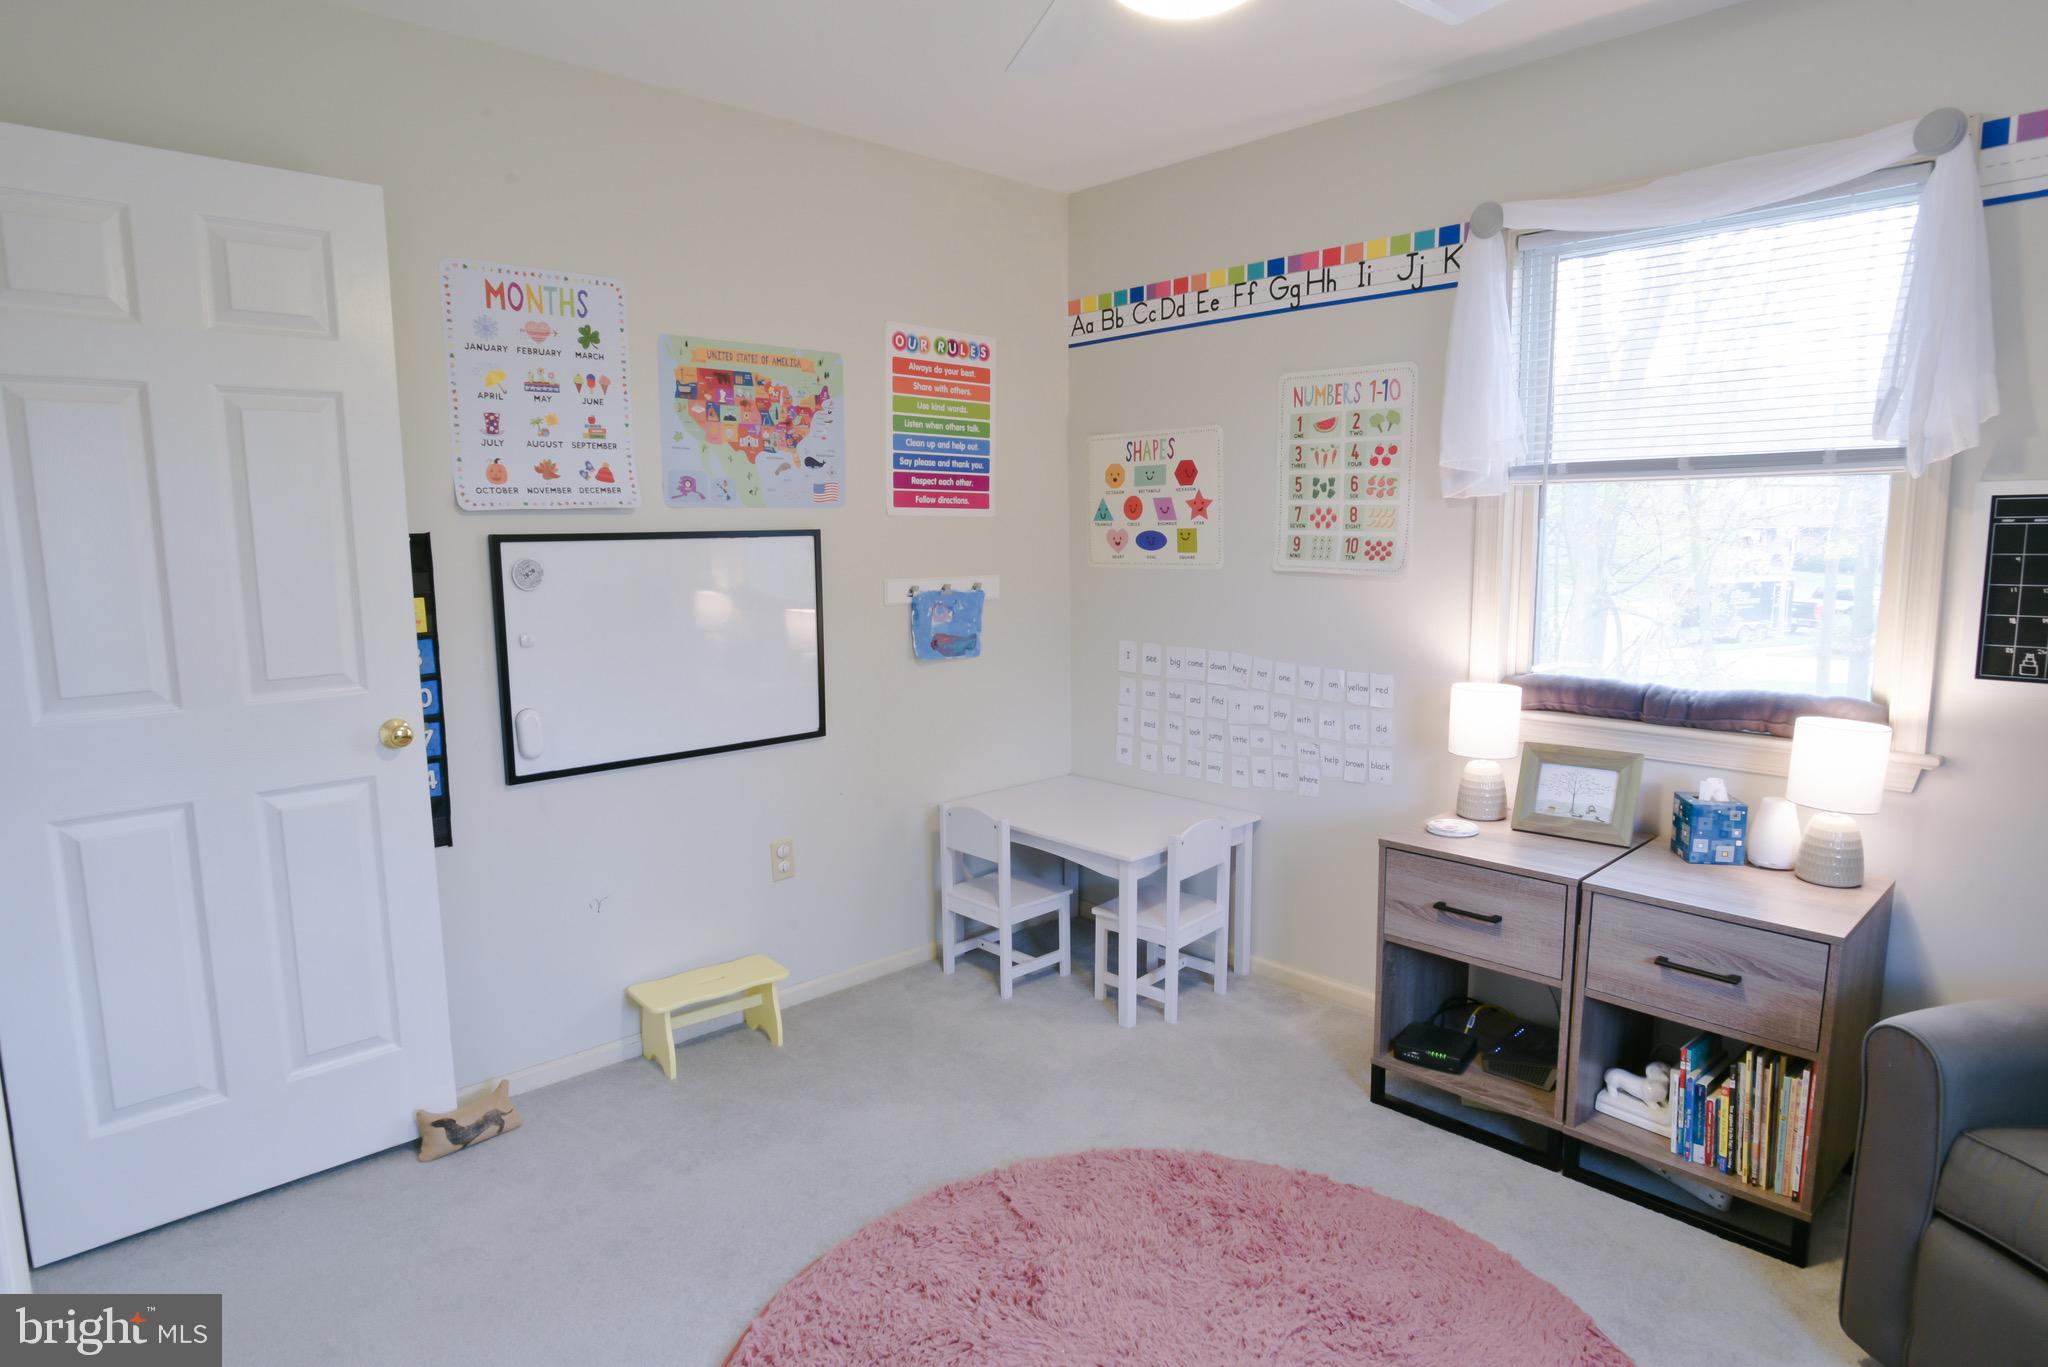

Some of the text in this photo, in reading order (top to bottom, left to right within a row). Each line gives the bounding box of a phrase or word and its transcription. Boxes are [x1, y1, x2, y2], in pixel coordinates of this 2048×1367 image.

[484, 278, 588, 318] MONTHS
[1071, 315, 1094, 336] Aa
[1102, 307, 1124, 331] Bb
[1132, 302, 1156, 324] Cc
[1161, 294, 1185, 320] Dd
[1197, 290, 1220, 314] Ee
[1234, 281, 1258, 308] Ff
[1270, 276, 1300, 308] Gg
[1306, 268, 1336, 296] Hh
[1358, 262, 1372, 287] Ii
[1397, 252, 1424, 290] Jj
[464, 342, 508, 353] JANUARY
[517, 346, 562, 357] FEBRUARY
[894, 334, 987, 360] OUR RULES
[575, 352, 604, 360] MARCH
[706, 351, 801, 368] UNITED STATES OF AMERICA
[908, 362, 976, 377] Always do your best.
[478, 392, 504, 400] APRIL
[912, 382, 972, 395] Share with others.
[1293, 378, 1400, 408] NUMBERS 1-10
[917, 401, 968, 413] Use kind words.
[904, 419, 923, 428] Listen
[925, 421, 943, 430] when
[945, 423, 965, 431] others
[1297, 416, 1303, 432] 1
[1352, 412, 1361, 430] 2
[526, 440, 563, 448] AUGUST
[906, 438, 925, 447] Clean
[927, 441, 936, 449] up
[952, 442, 966, 451] help
[1126, 437, 1176, 462] SHAPES
[1351, 443, 1360, 459] 4
[1295, 445, 1303, 462] 3
[899, 457, 984, 470] Say please and thank you.
[912, 477, 937, 486] Respect
[1295, 476, 1303, 492] 5
[1350, 475, 1359, 492] 6
[938, 496, 970, 504] directions.
[1295, 506, 1302, 522] 7
[1350, 506, 1358, 522] 8
[1293, 536, 1301, 551] 9
[1345, 538, 1359, 554] 10
[1170, 657, 1181, 668] big
[1210, 663, 1226, 671] down
[1232, 664, 1248, 674] here
[1257, 670, 1267, 678] not
[1304, 680, 1314, 688] my
[1348, 683, 1368, 692] yellow
[1190, 696, 1201, 704] and
[1211, 696, 1224, 705] find
[1273, 711, 1288, 720] play
[1297, 716, 1311, 724] with
[1376, 724, 1388, 733] did
[1189, 728, 1200, 736] look
[1208, 732, 1222, 741] jump
[1232, 735, 1248, 744] little
[1324, 755, 1340, 766] help
[1345, 760, 1365, 769] brown
[1370, 761, 1390, 771] black
[1299, 775, 1318, 784] where
